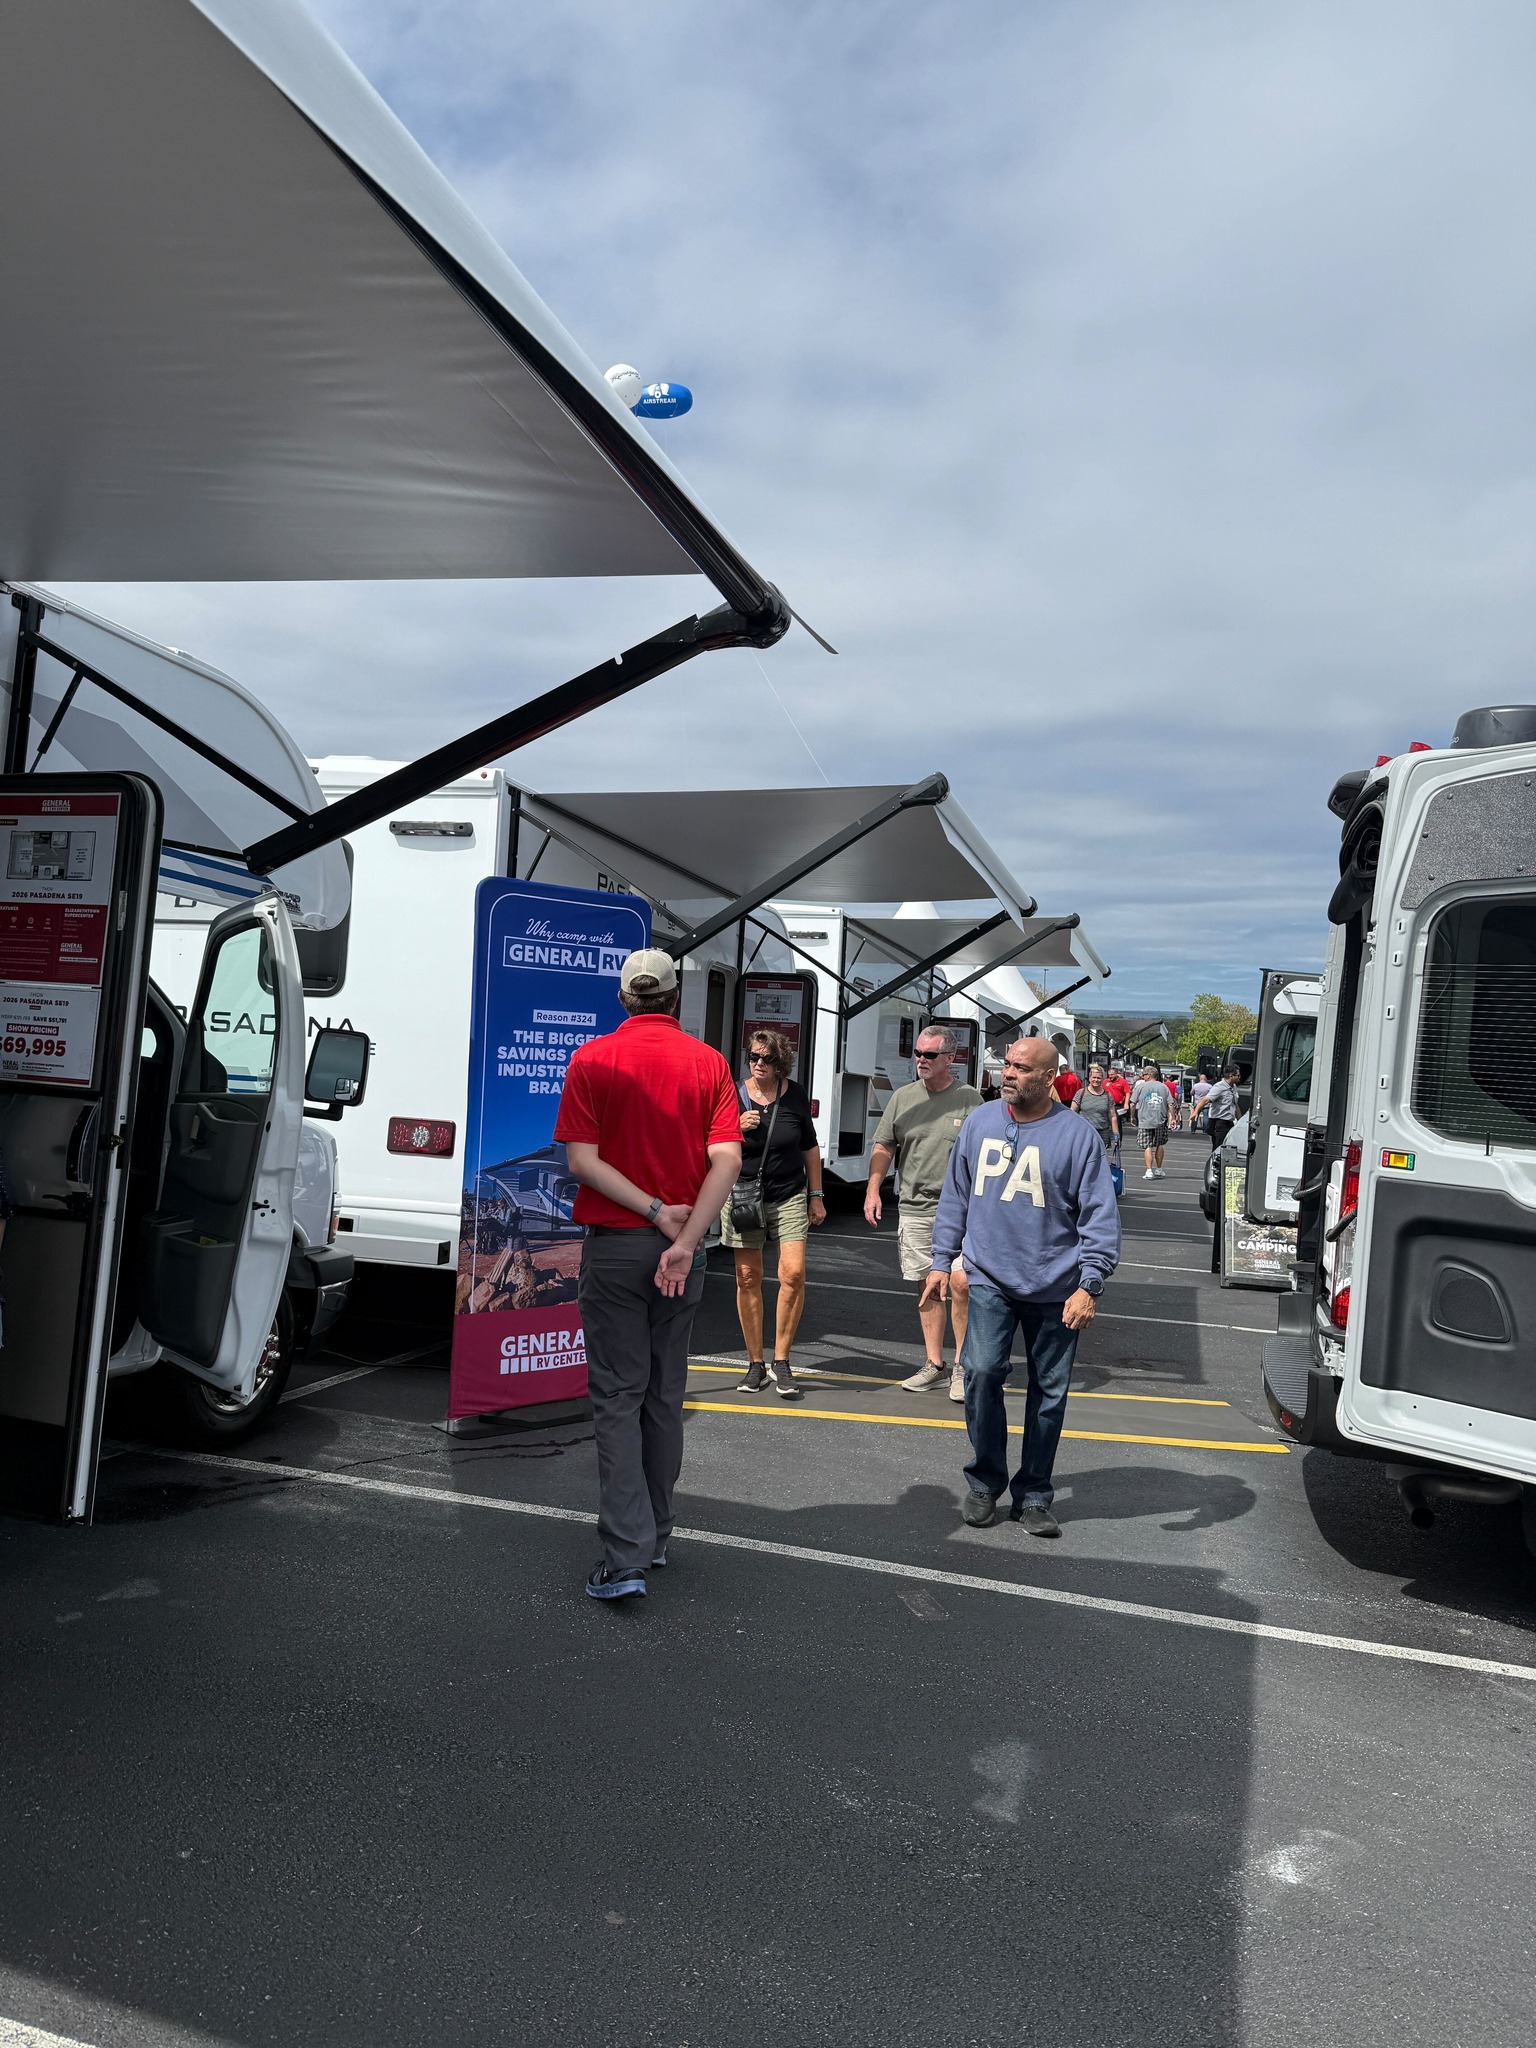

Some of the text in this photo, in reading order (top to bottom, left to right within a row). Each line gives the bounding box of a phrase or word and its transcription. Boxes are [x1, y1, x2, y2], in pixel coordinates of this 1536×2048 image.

[526, 918, 615, 945] Why camp with
[509, 944, 626, 970] GENERAL RV
[19, 998, 53, 1006] PASADENA
[537, 1012, 592, 1024] Reason #324
[30, 1026, 57, 1034] PRICING
[513, 1030, 603, 1046] THE BIGGE
[497, 1047, 567, 1061] SAVINGS
[498, 1063, 569, 1078] INDUSTR
[529, 1081, 565, 1094] BRA
[973, 1138, 1046, 1208] PA
[1237, 1240, 1297, 1253] CAMPING
[500, 1328, 586, 1357] GENERA
[537, 1351, 586, 1368] RV CENTE
